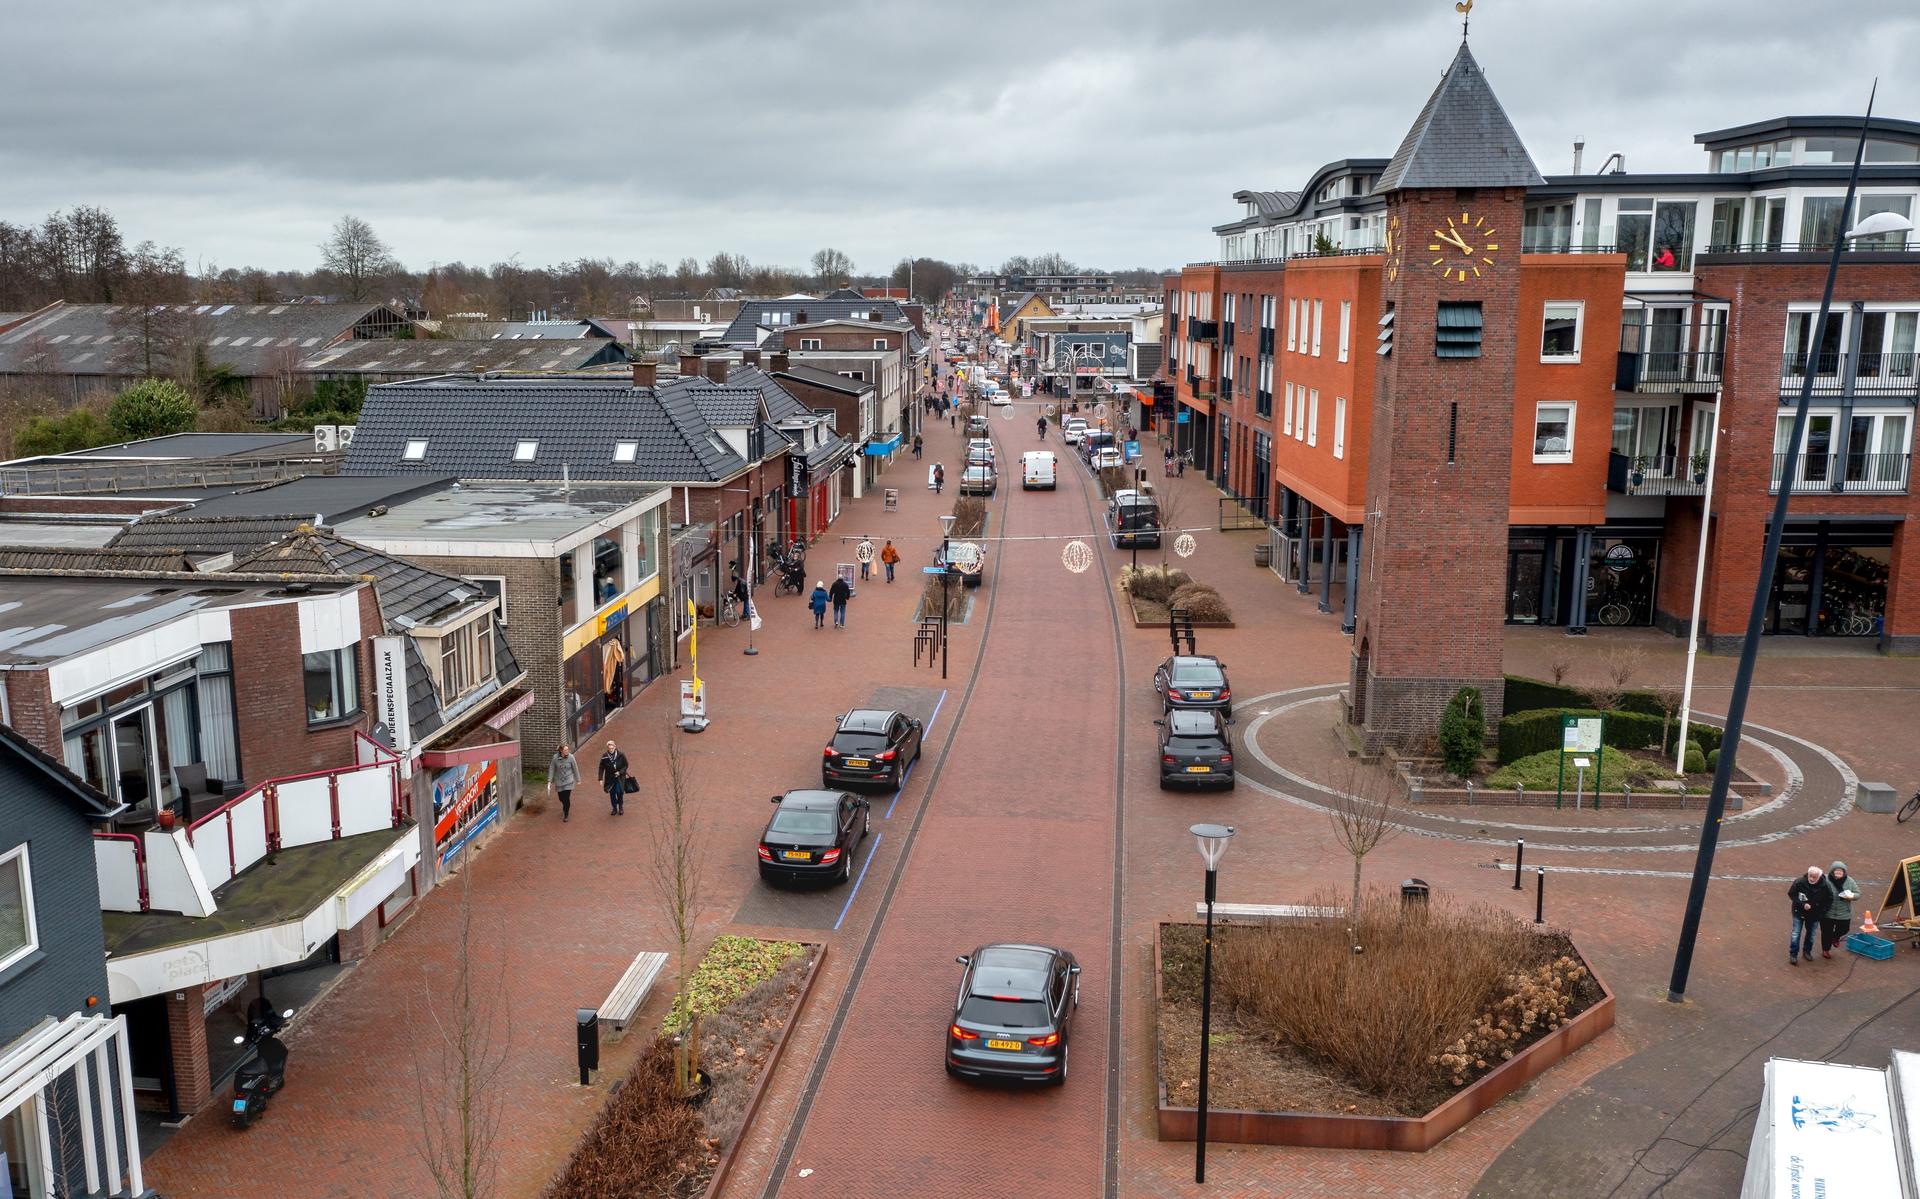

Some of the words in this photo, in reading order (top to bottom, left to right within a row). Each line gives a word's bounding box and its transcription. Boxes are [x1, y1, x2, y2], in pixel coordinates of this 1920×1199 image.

[383, 651, 396, 734] DIERENSPECIAALZAAK
[390, 738, 397, 748] UW
[455, 782, 479, 816] VERKOCHT
